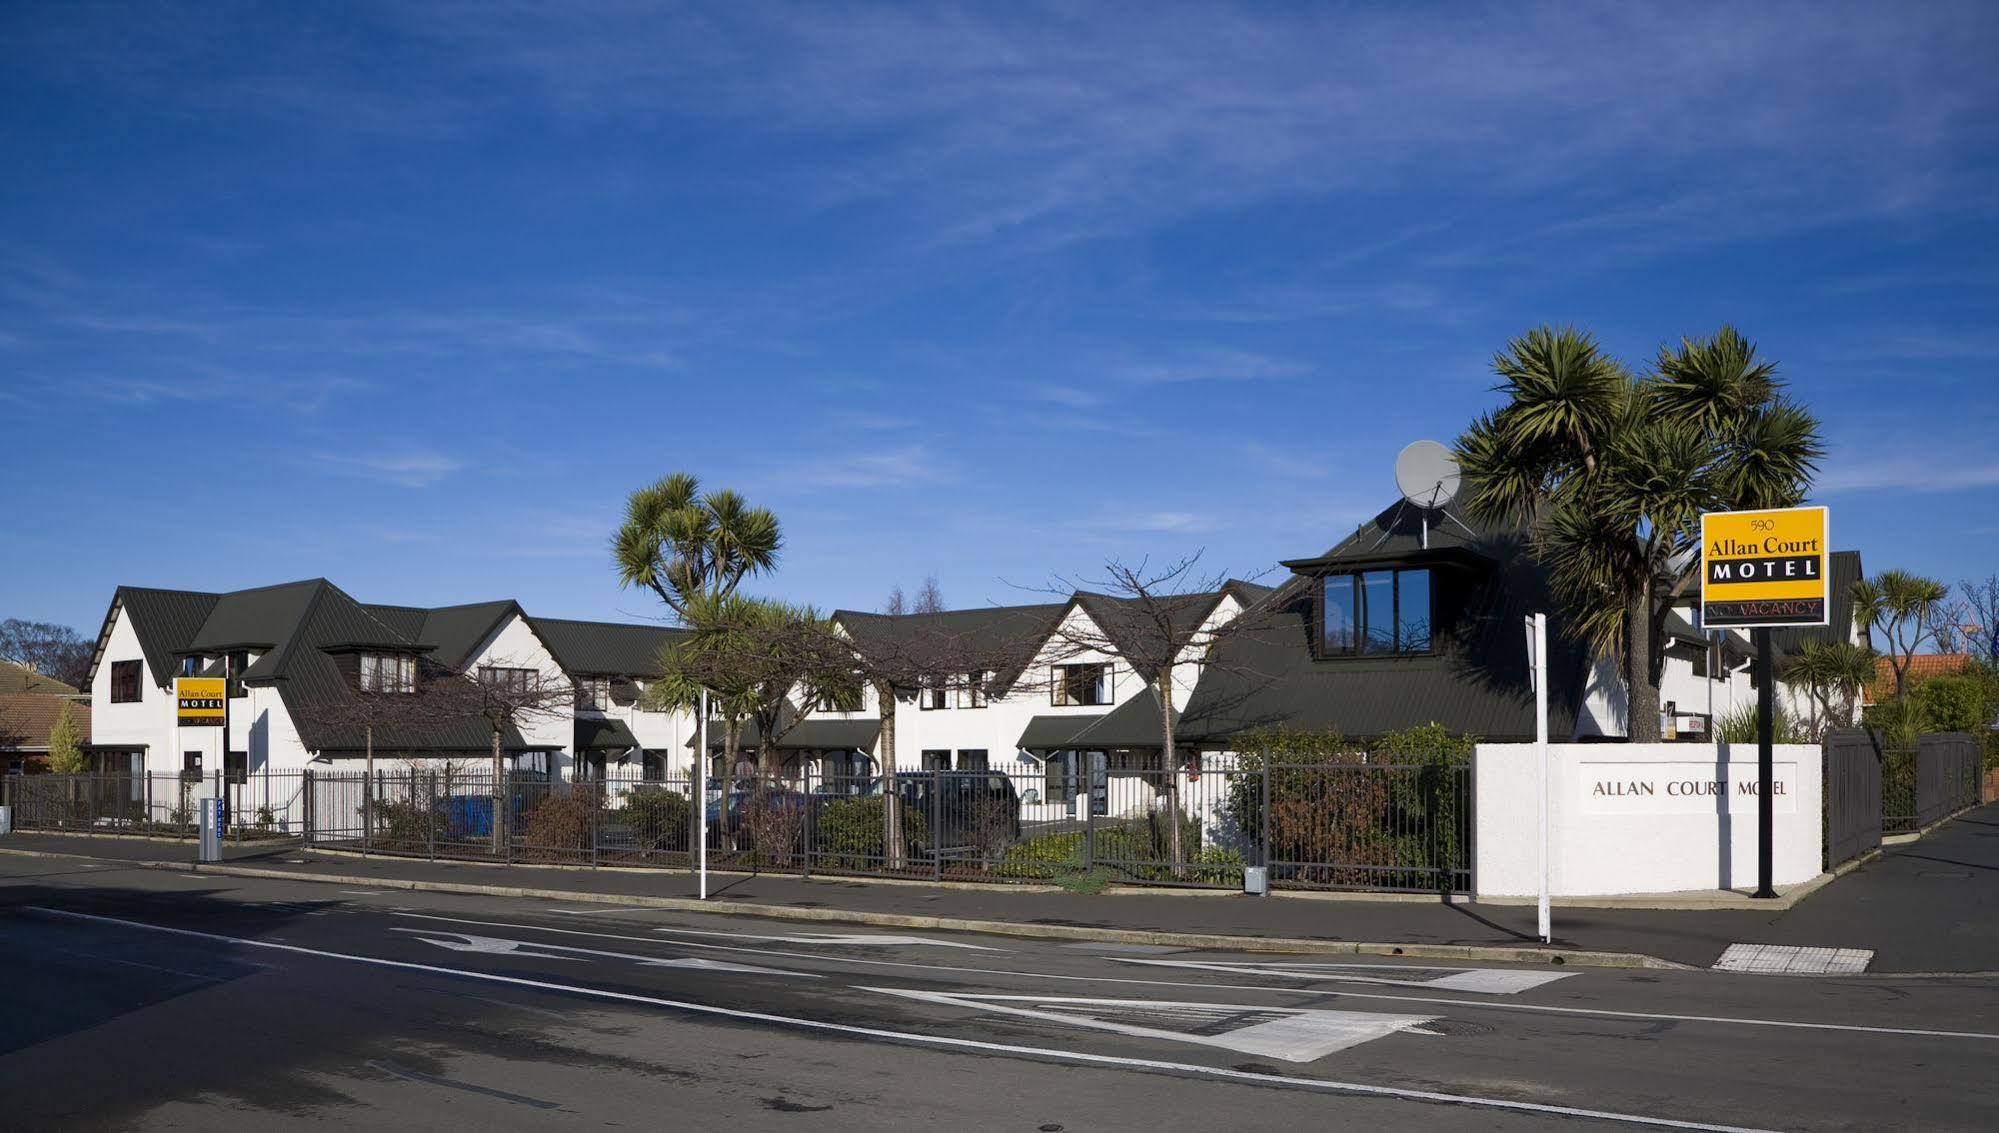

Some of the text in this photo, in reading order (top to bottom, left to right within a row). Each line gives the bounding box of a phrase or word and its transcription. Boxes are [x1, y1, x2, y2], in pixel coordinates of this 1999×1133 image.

[1751, 519, 1774, 531] 590
[1709, 537, 1817, 557] Allan Court
[1713, 560, 1815, 579] MOTEL
[1740, 602, 1817, 616] VACANCY
[179, 689, 222, 698] Allan Court
[1592, 781, 1787, 796] ALLAN COURT MOEL
